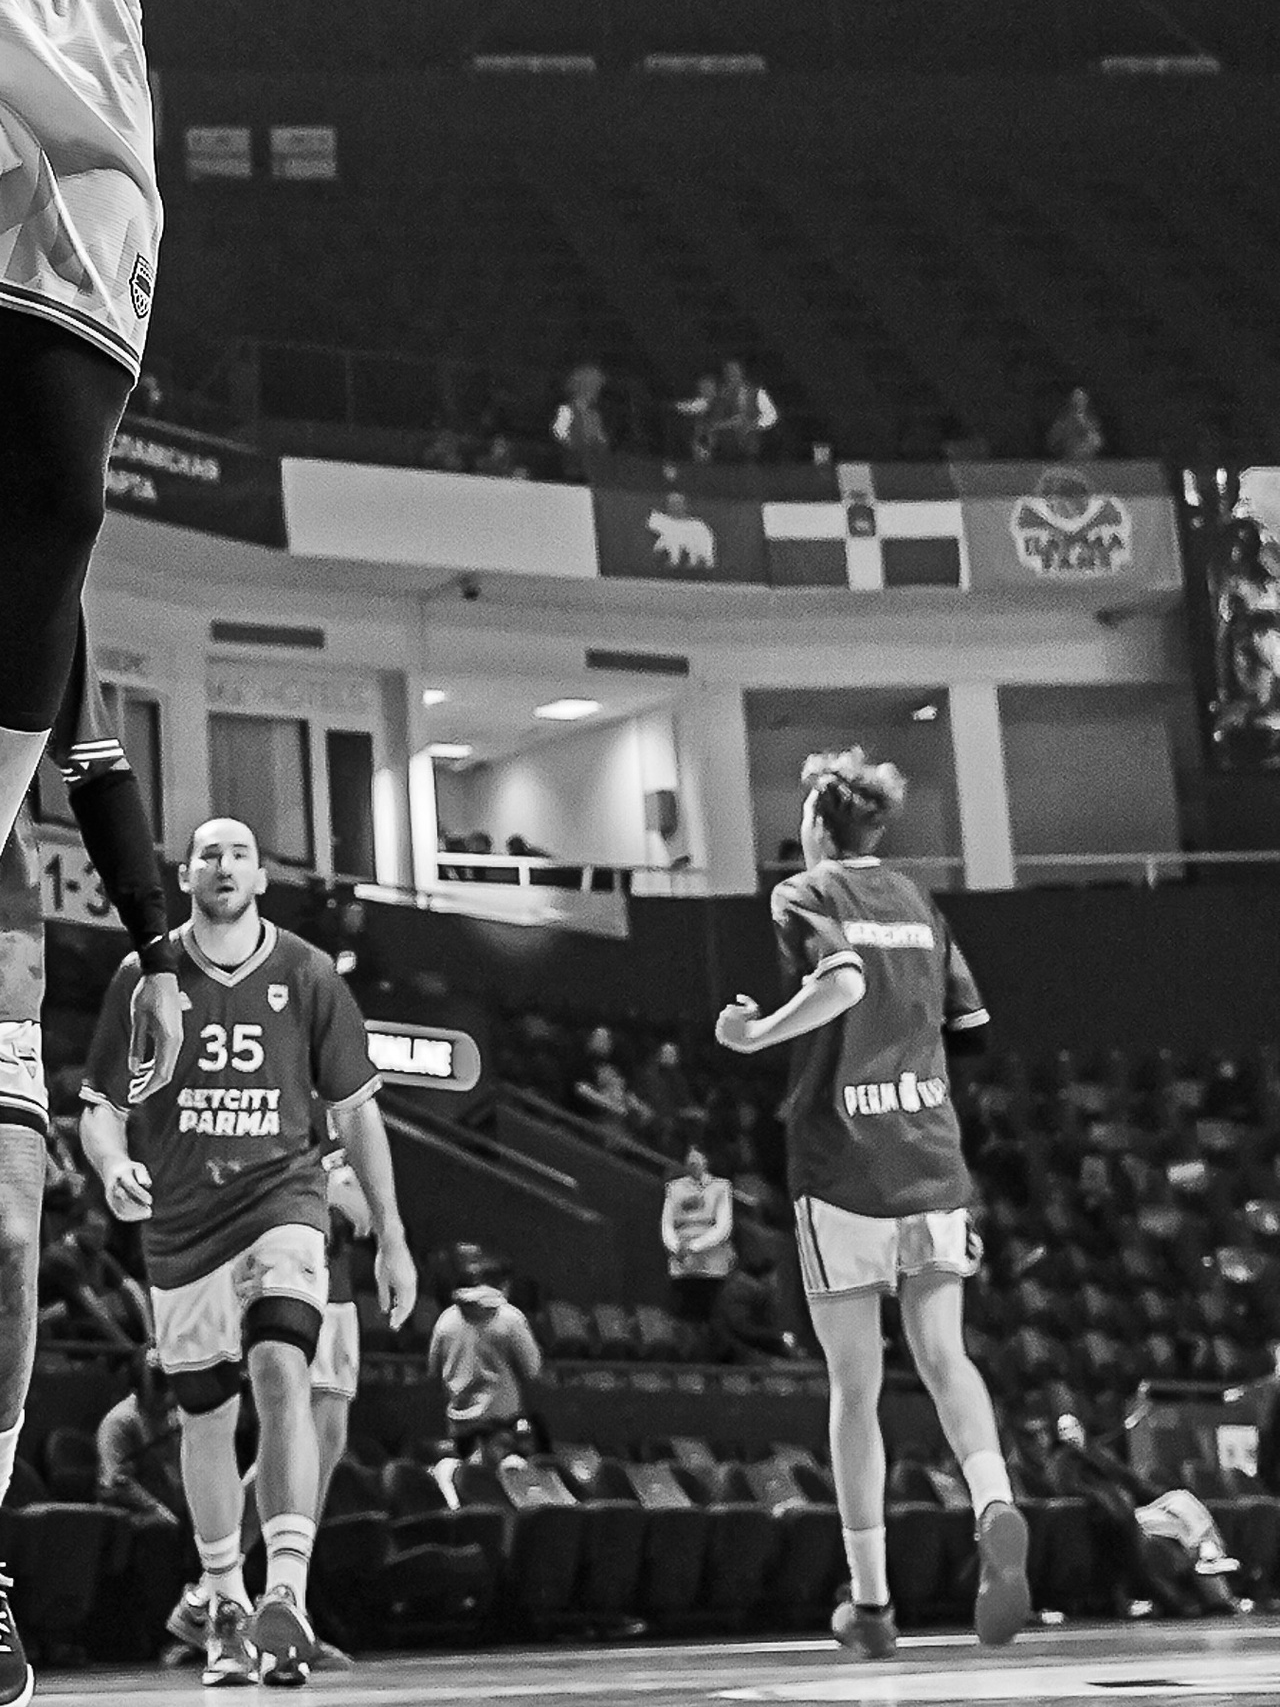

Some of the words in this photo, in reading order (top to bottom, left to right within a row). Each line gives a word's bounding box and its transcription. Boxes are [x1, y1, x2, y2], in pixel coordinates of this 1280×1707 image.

[197, 1023, 265, 1073] 35
[177, 1087, 281, 1110] BETCITY
[178, 1109, 281, 1137] PARMA
